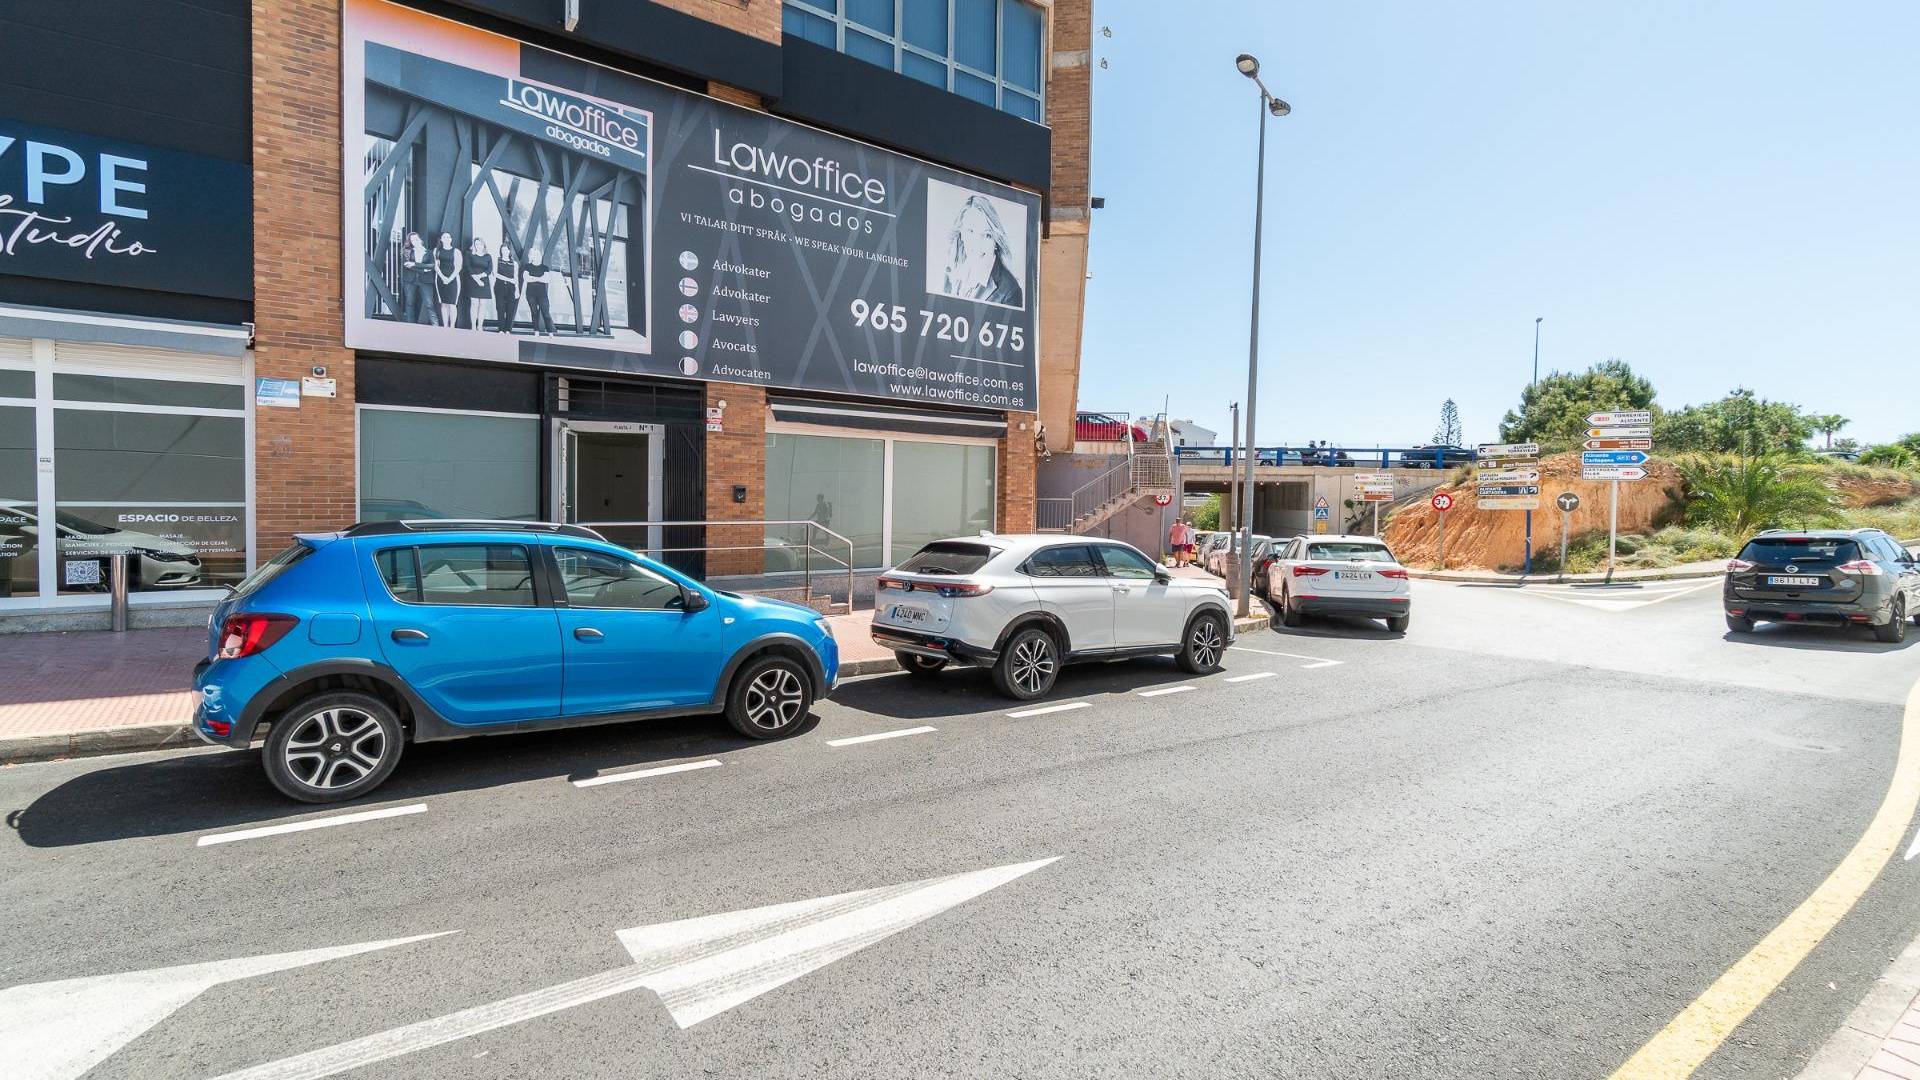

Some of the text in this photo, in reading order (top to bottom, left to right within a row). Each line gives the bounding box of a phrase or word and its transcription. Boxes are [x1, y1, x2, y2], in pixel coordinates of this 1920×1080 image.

[508, 79, 638, 147] Lawoffice
[546, 125, 610, 157] abogados
[714, 129, 885, 204] Lawoffice
[728, 188, 873, 234] abogados
[680, 212, 692, 223] VI
[694, 214, 727, 231] TALAR
[730, 222, 754, 236] DITT
[756, 227, 787, 243] SPRÅK
[794, 235, 810, 247] WE
[811, 240, 840, 254] SPEAK
[841, 245, 864, 259] YOUR
[866, 251, 909, 268] LANGUAGE
[712, 259, 771, 279] Advokater
[712, 286, 772, 304] Advokater
[712, 309, 760, 327] Lawyers
[850, 298, 1025, 352] 965 720 675
[712, 338, 757, 353] Avocats
[712, 363, 771, 380] Advocaten
[854, 358, 1024, 391] lawoffice@lawoffice.com.es
[890, 382, 1024, 407] www.lawoffice.com.es
[118, 514, 179, 523] ESPACIO
